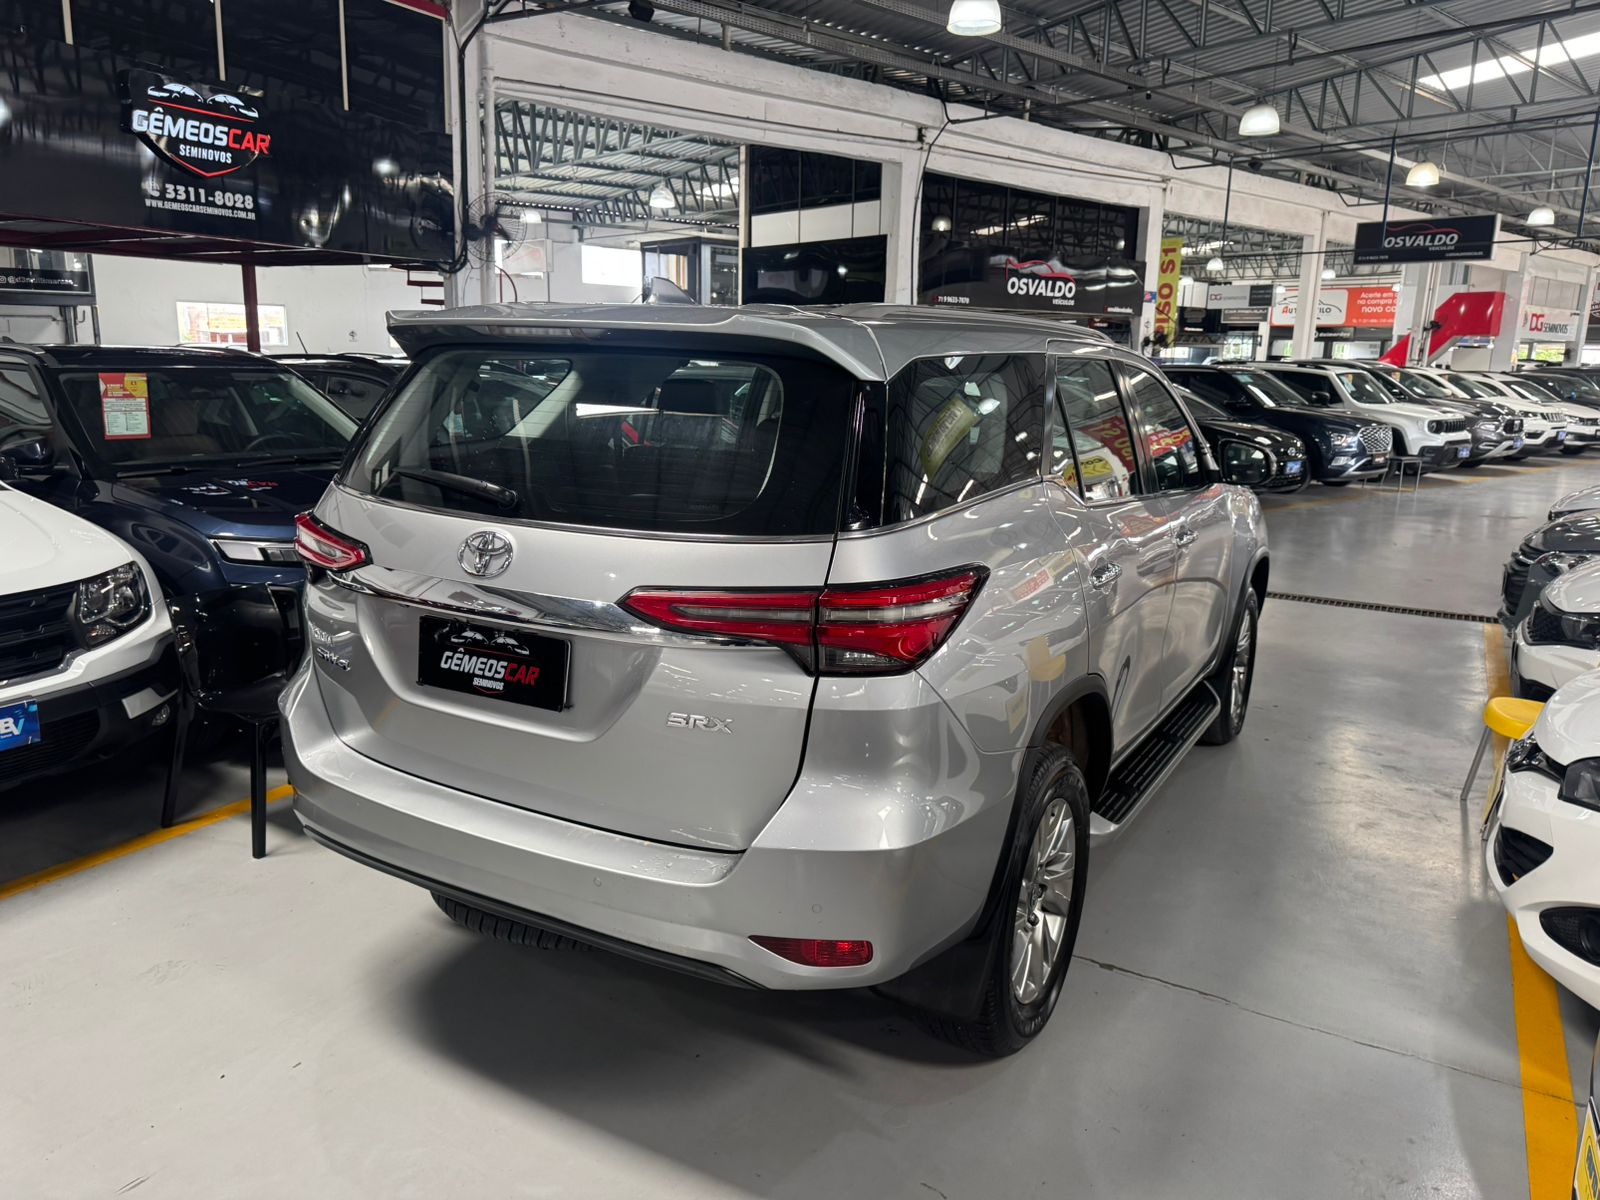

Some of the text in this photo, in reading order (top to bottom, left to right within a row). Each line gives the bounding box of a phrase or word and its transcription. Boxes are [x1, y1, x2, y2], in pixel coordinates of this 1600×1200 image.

[132, 106, 271, 155] GÊMEOSCAR
[179, 144, 232, 164] SEMINOVOS
[164, 183, 254, 210] 3311-8028
[1384, 233, 1459, 248] OSVALDO
[1006, 276, 1076, 298] OSVALDO
[1529, 313, 1545, 331] DG
[440, 647, 540, 686] GÊMEOSCAR
[472, 677, 505, 690] SEMINOVOS
[666, 711, 733, 734] SRX
